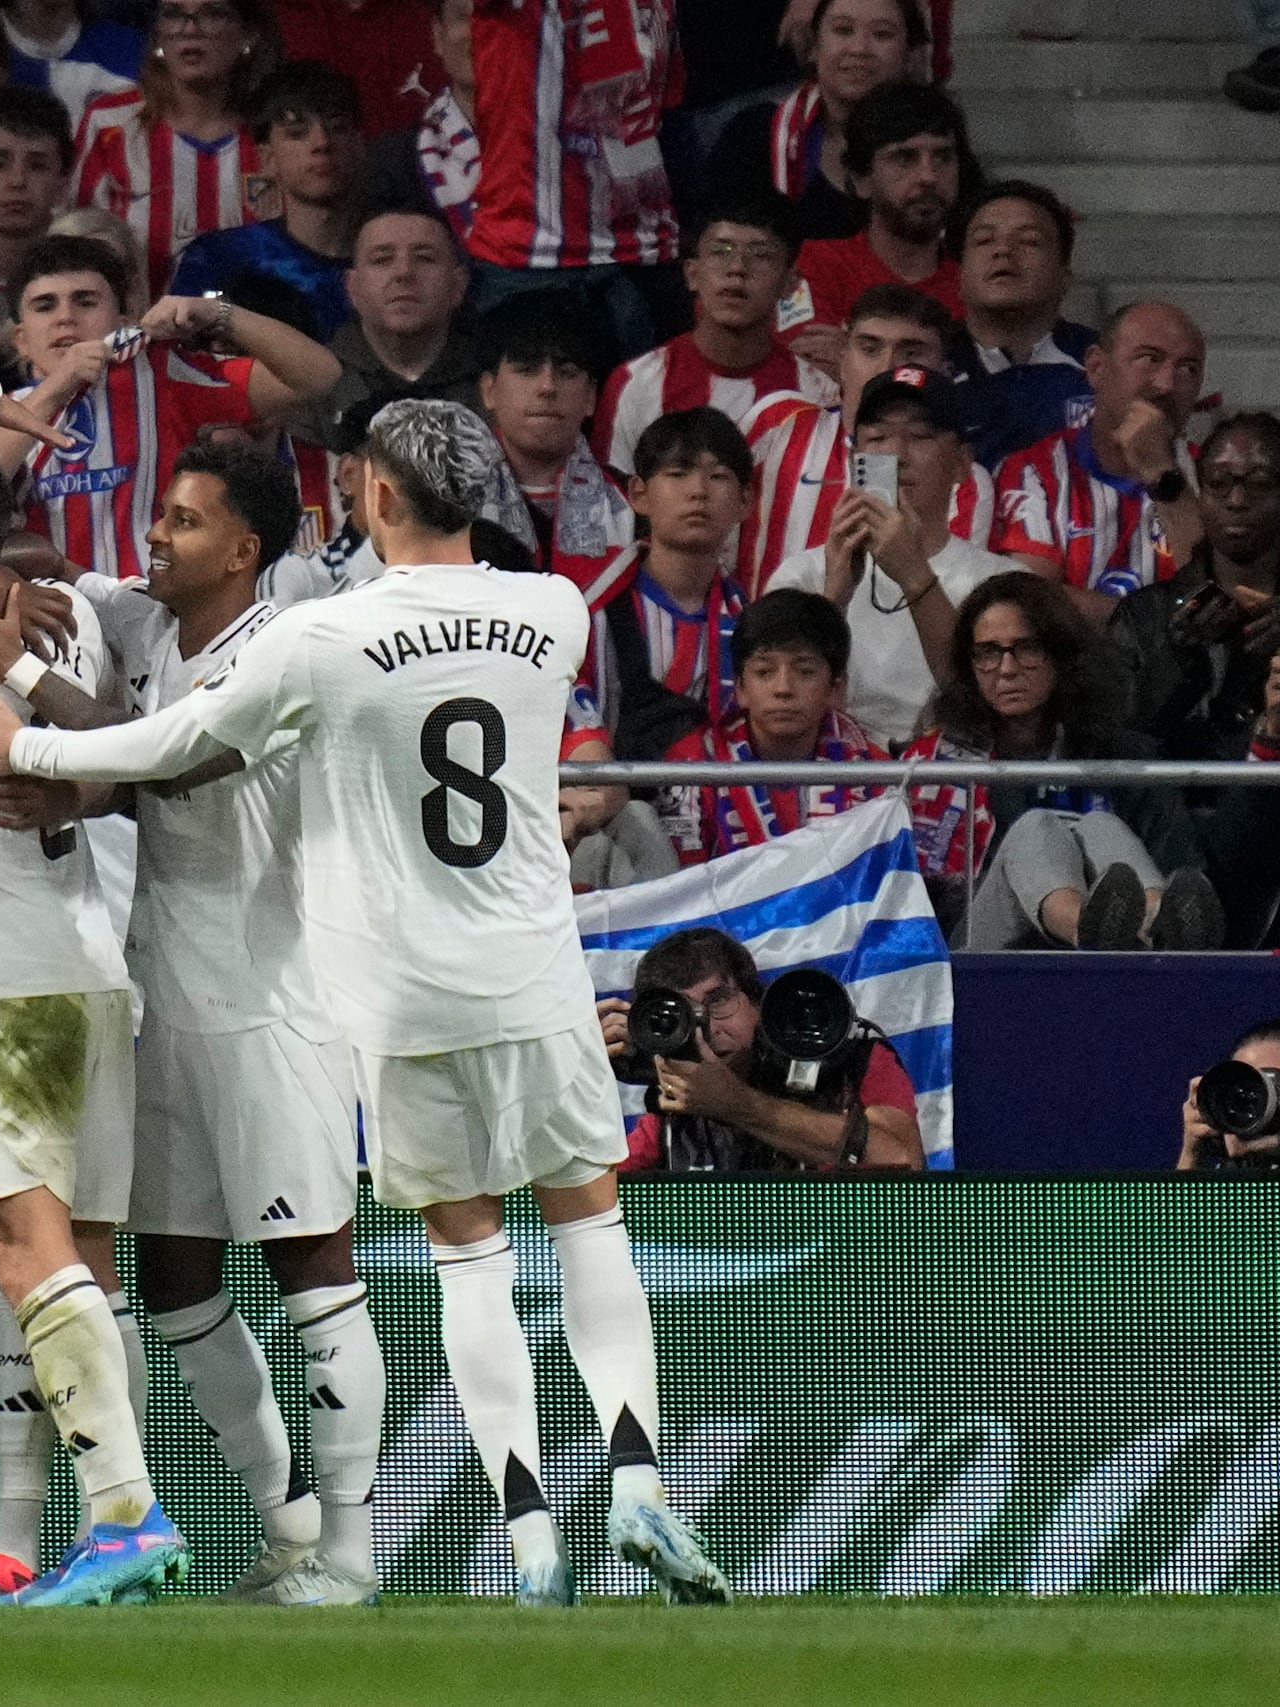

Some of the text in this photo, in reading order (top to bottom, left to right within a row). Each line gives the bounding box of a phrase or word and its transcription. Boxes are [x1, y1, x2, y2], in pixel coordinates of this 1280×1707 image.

[363, 618, 555, 674] VALVERDE
[419, 696, 508, 869] 8
[307, 1346, 341, 1363] MCF
